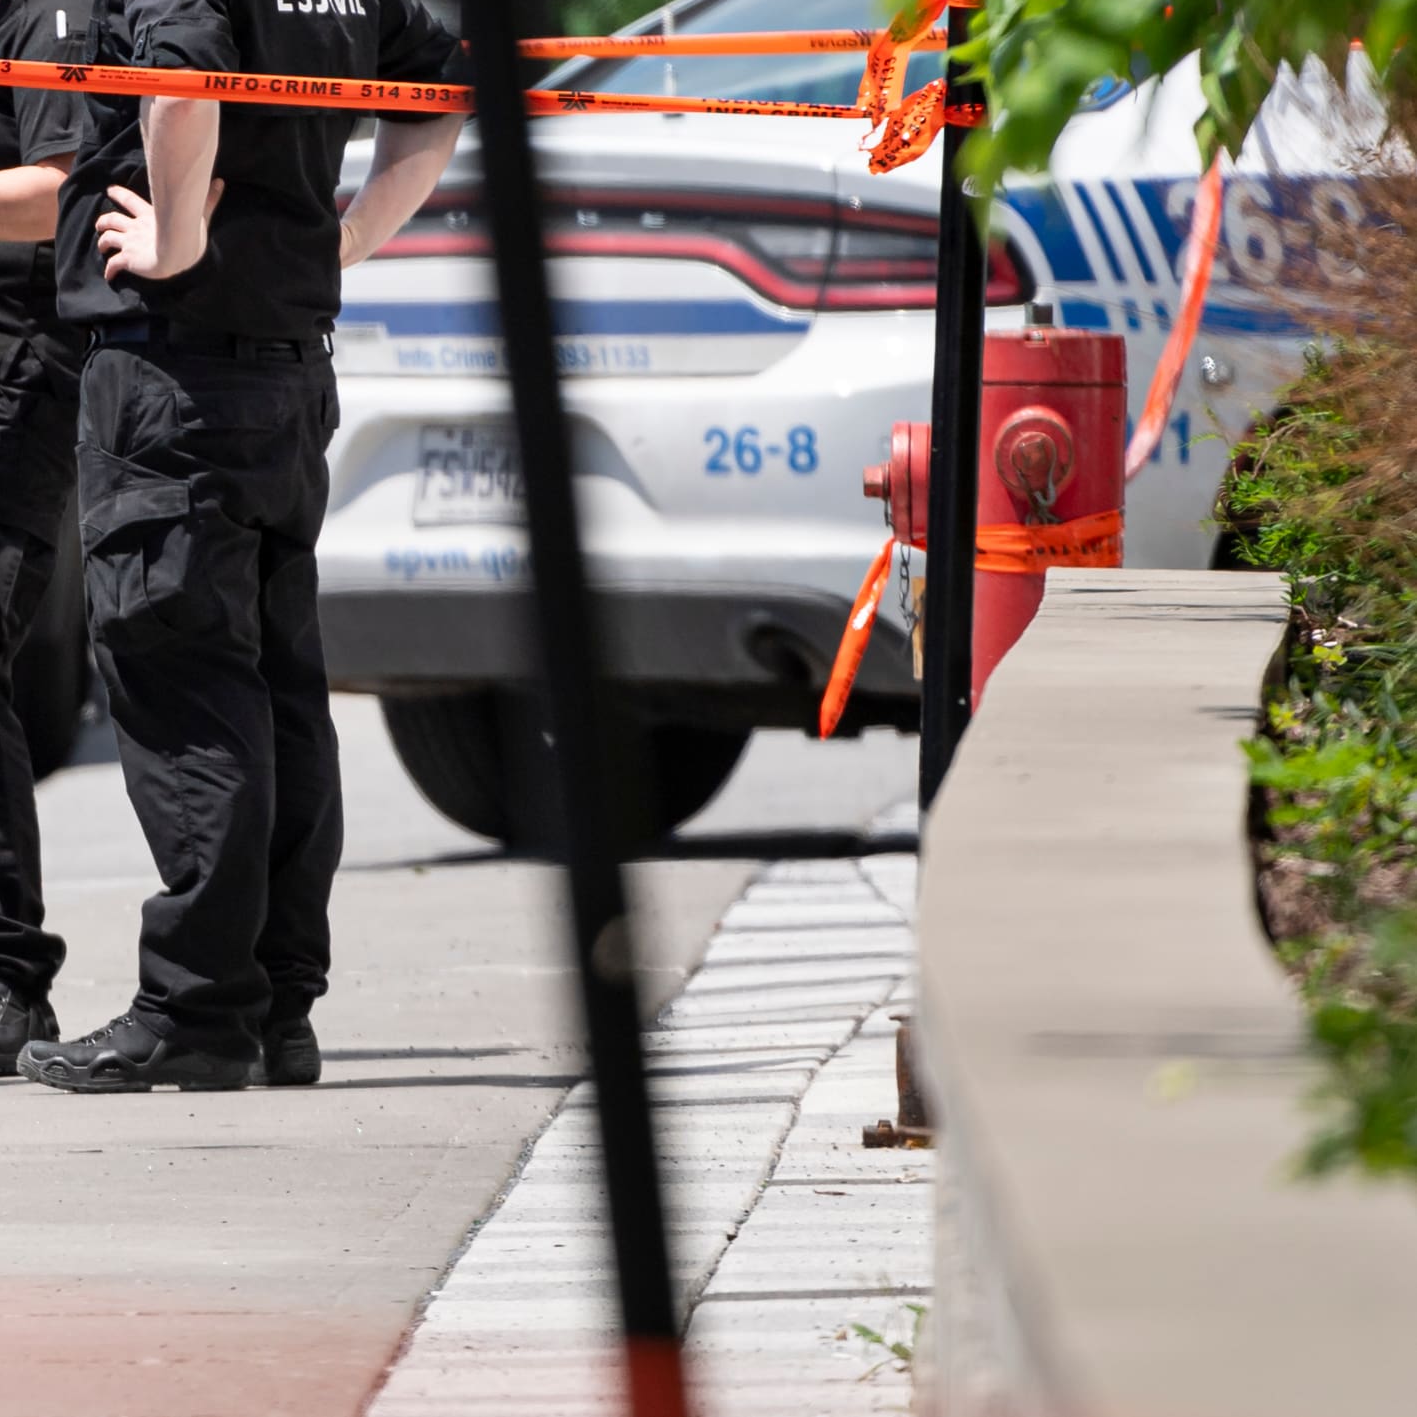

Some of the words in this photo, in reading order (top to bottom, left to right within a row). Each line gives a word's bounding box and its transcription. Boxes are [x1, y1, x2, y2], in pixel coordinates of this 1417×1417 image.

[204, 75, 343, 97] INFO-CRIME
[360, 84, 400, 99] 514
[703, 426, 820, 476] 26-8
